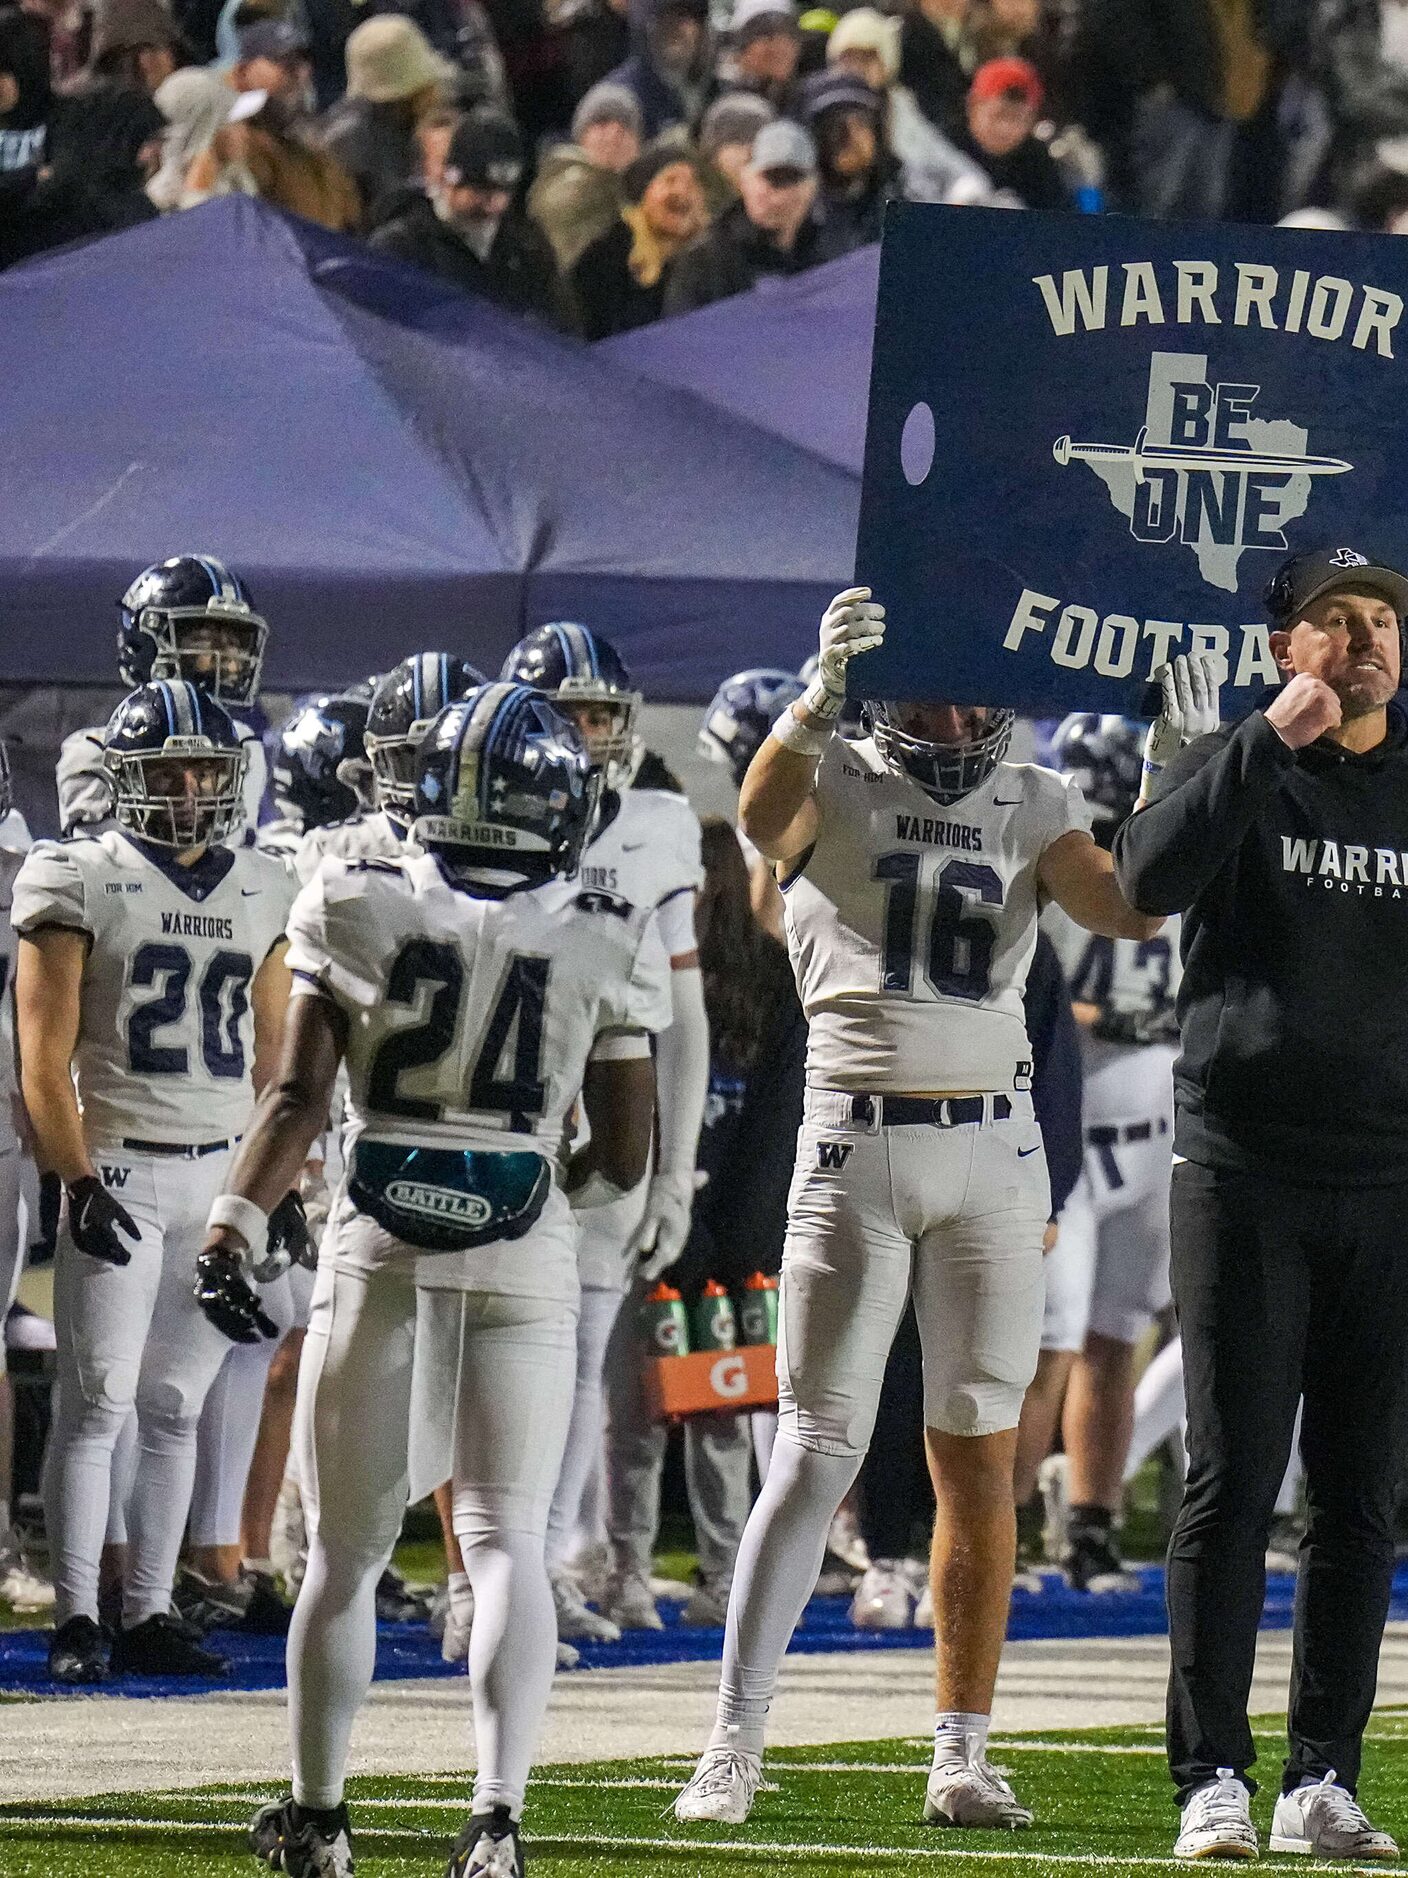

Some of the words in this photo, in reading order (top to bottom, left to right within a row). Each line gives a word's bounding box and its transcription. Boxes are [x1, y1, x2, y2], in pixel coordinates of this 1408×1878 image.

[1032, 260, 1404, 358] WARRIOR
[1169, 381, 1261, 451] BE
[1129, 468, 1289, 550] ONE
[1002, 588, 1281, 687] FOOTBA
[426, 820, 517, 846] WARRIORS
[895, 814, 983, 853] WARRIORS
[105, 882, 123, 894] FOR
[160, 911, 234, 941] WARRIORS
[871, 851, 1006, 1006] 16
[124, 941, 254, 1079] 20
[366, 935, 553, 1134] 24
[100, 1164, 132, 1189] W
[816, 1141, 853, 1170] W
[393, 1183, 486, 1219] BATTLE
[710, 1354, 749, 1398] G
